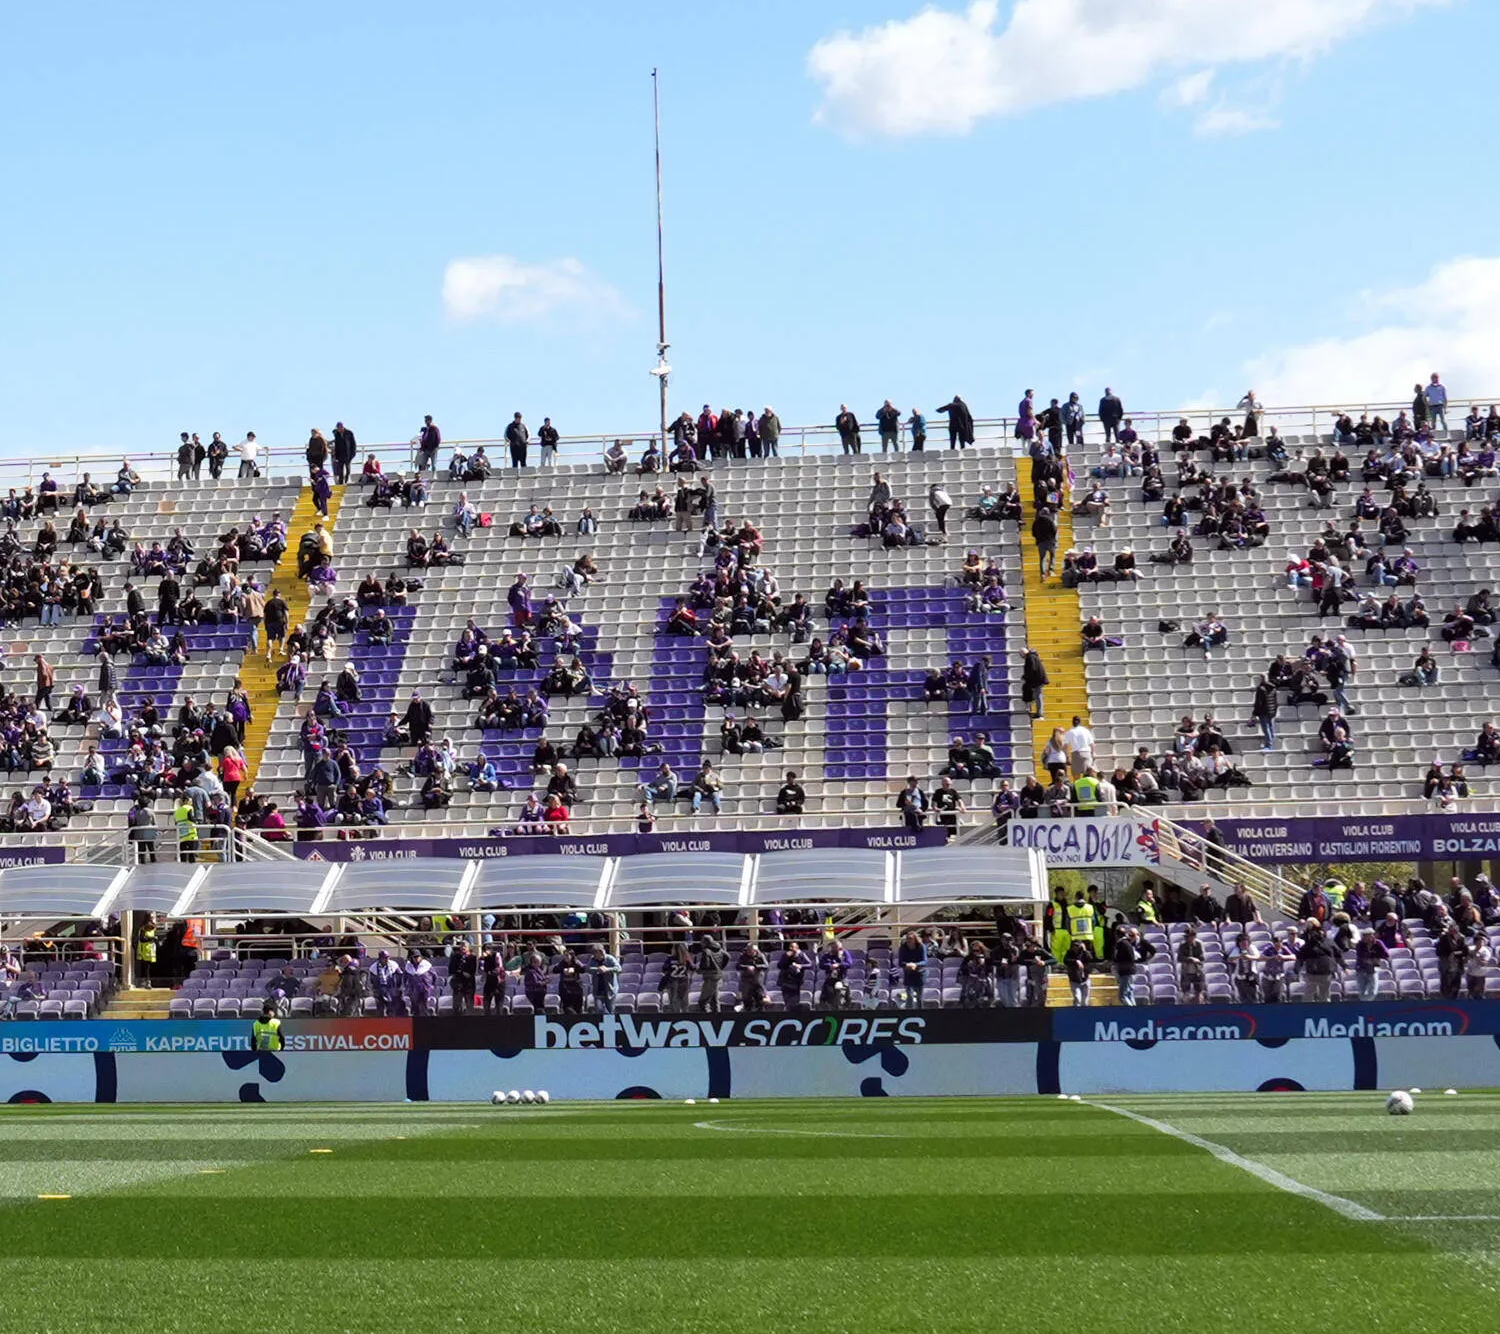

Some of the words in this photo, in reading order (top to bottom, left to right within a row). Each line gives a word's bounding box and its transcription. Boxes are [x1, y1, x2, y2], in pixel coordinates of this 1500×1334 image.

[1237, 828, 1263, 838] VIOLA
[1264, 827, 1288, 837] CLUB
[1342, 825, 1369, 836] VIOLA
[1371, 824, 1394, 835] CLUB
[1451, 822, 1476, 833] VIOLA
[764, 839, 789, 850] VIOLA
[791, 838, 813, 848] CLUB
[867, 837, 892, 847] VIOLA
[894, 836, 916, 846] CLUB
[1013, 824, 1081, 853] RICCA
[459, 847, 484, 857] VIOLA
[485, 846, 507, 856] CLUB
[560, 845, 584, 855] VIOLA
[586, 843, 608, 854] CLUB
[661, 841, 687, 852] VIOLA
[688, 840, 710, 851] CLUB
[1250, 842, 1312, 856] CONVERSANO
[1320, 841, 1369, 856] CASTIGLION
[1370, 839, 1421, 854] FIORENTINO
[370, 851, 392, 860] VIOLA
[394, 850, 416, 859] CLUB
[0, 858, 22, 867] VIOLA
[24, 857, 45, 866] CLUB
[670, 964, 687, 978] 22
[534, 1014, 736, 1048] betway
[1094, 1020, 1240, 1041] Mediacom
[1304, 1016, 1453, 1038] Mediacom
[2, 1037, 99, 1052] BIGLIETTO
[145, 1034, 410, 1051] KAPPAFUTUESTIVAL.COM
